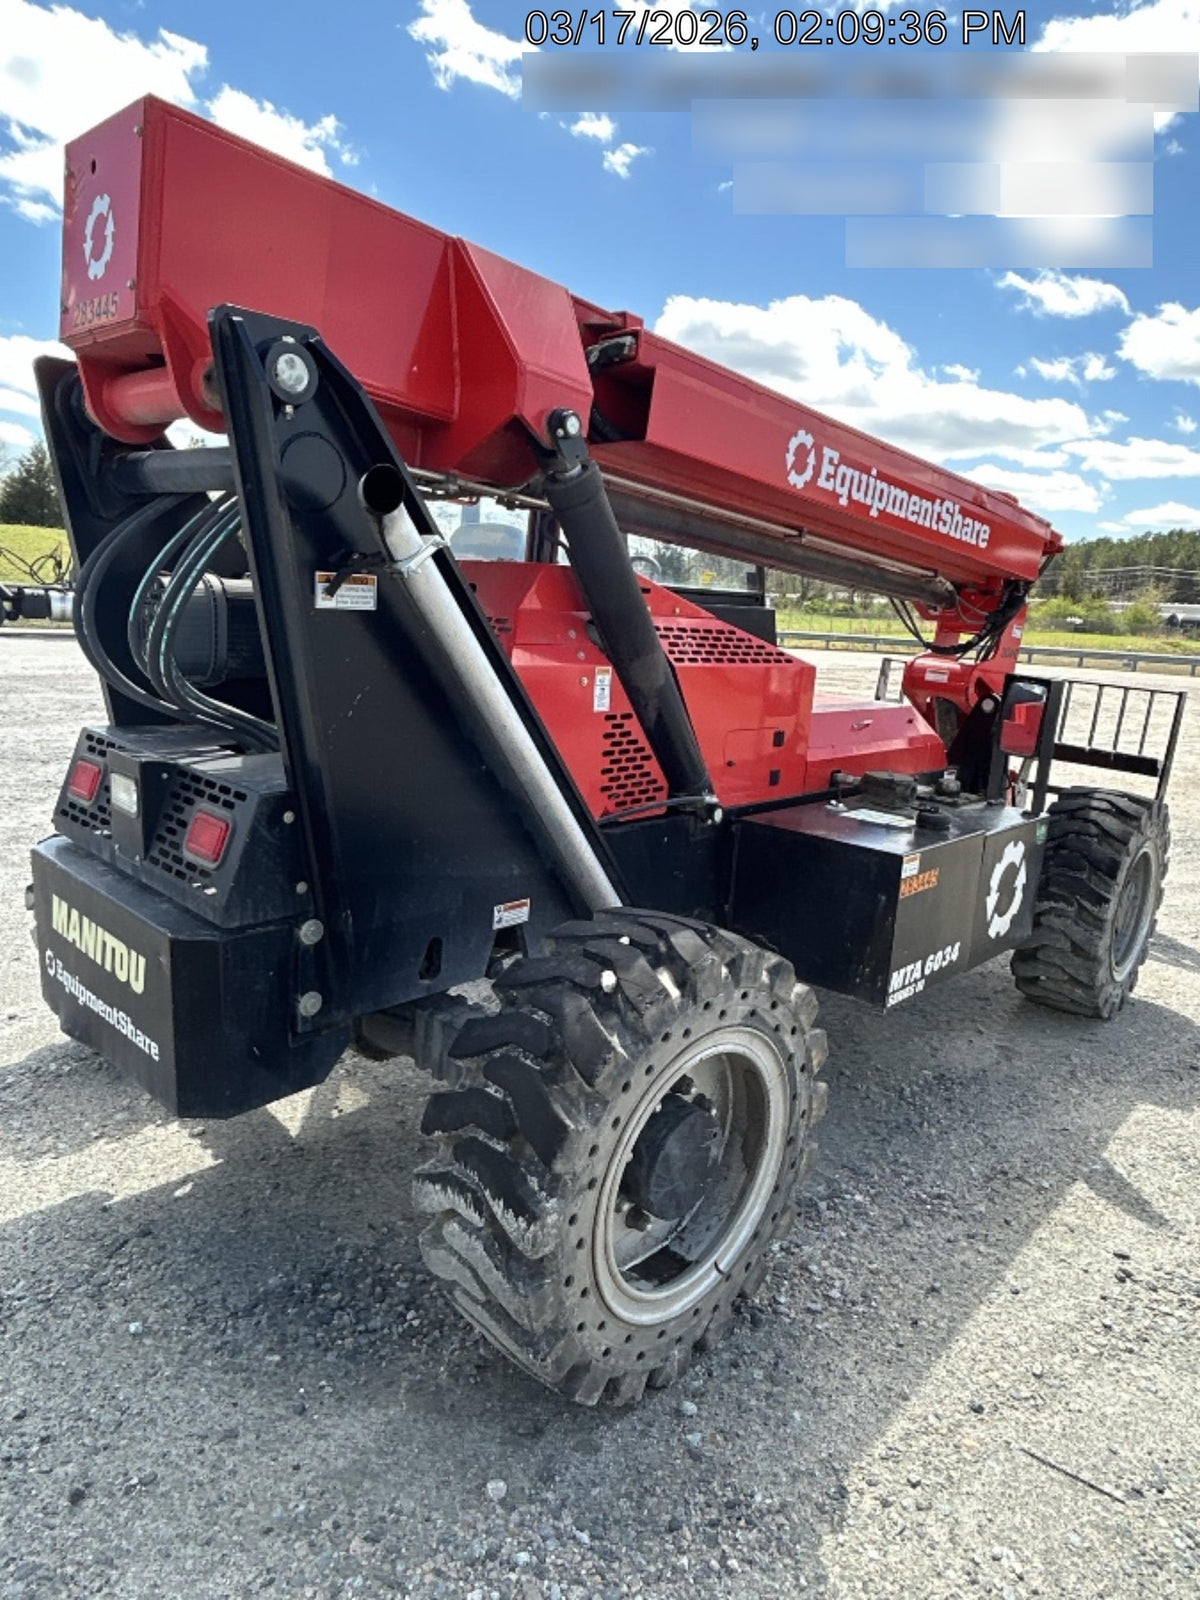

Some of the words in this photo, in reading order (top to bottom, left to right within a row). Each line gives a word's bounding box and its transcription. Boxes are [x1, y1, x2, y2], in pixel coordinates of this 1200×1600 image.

[74, 290, 119, 328] 283445
[817, 446, 990, 549] EquipmentShare
[52, 893, 147, 995] MANITOU
[888, 959, 923, 994] MTA
[924, 941, 961, 976] 6034
[56, 957, 160, 1062] EquipmentShare
